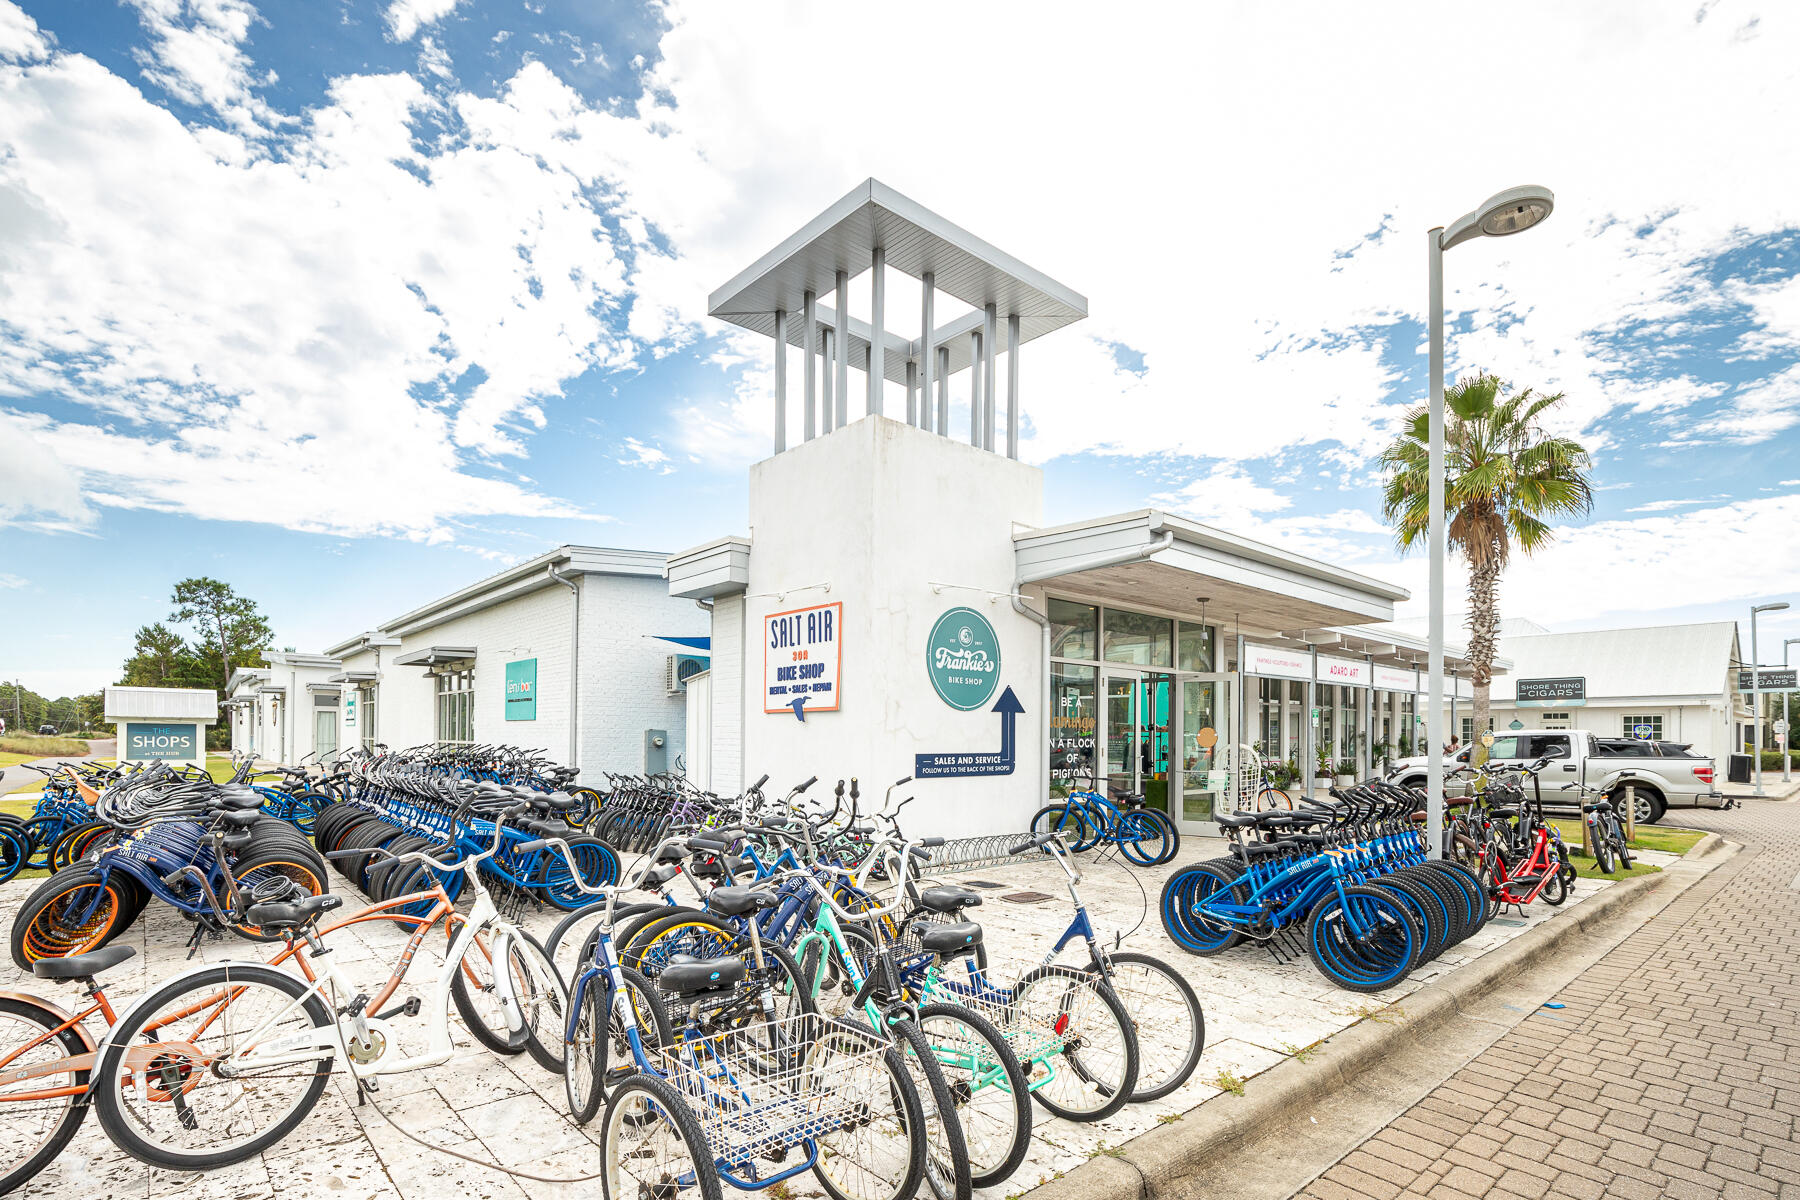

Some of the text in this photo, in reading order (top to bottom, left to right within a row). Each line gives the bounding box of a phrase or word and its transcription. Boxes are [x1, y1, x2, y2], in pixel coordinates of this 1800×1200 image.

[771, 610, 832, 649] SALT AIR
[777, 663, 825, 682] BIKE SHOP
[1330, 665, 1359, 678] ADARO ART
[948, 676, 983, 686] BIKE SHOP
[769, 682, 832, 695] RENTAL SALES REPAIR
[1527, 689, 1574, 697] CIGARS
[1061, 697, 1082, 707] BE A
[1050, 701, 1096, 733] lamingo
[132, 736, 190, 748] SHOPS
[1058, 738, 1065, 748] A
[1067, 738, 1096, 748] FLOCK
[934, 757, 956, 765] SALES
[975, 756, 1001, 764] SERVICE
[1066, 753, 1079, 763] OF
[118, 849, 136, 858] SALT
[136, 853, 149, 862] AIR
[1287, 864, 1301, 875] SALT
[1301, 860, 1312, 869] AIR
